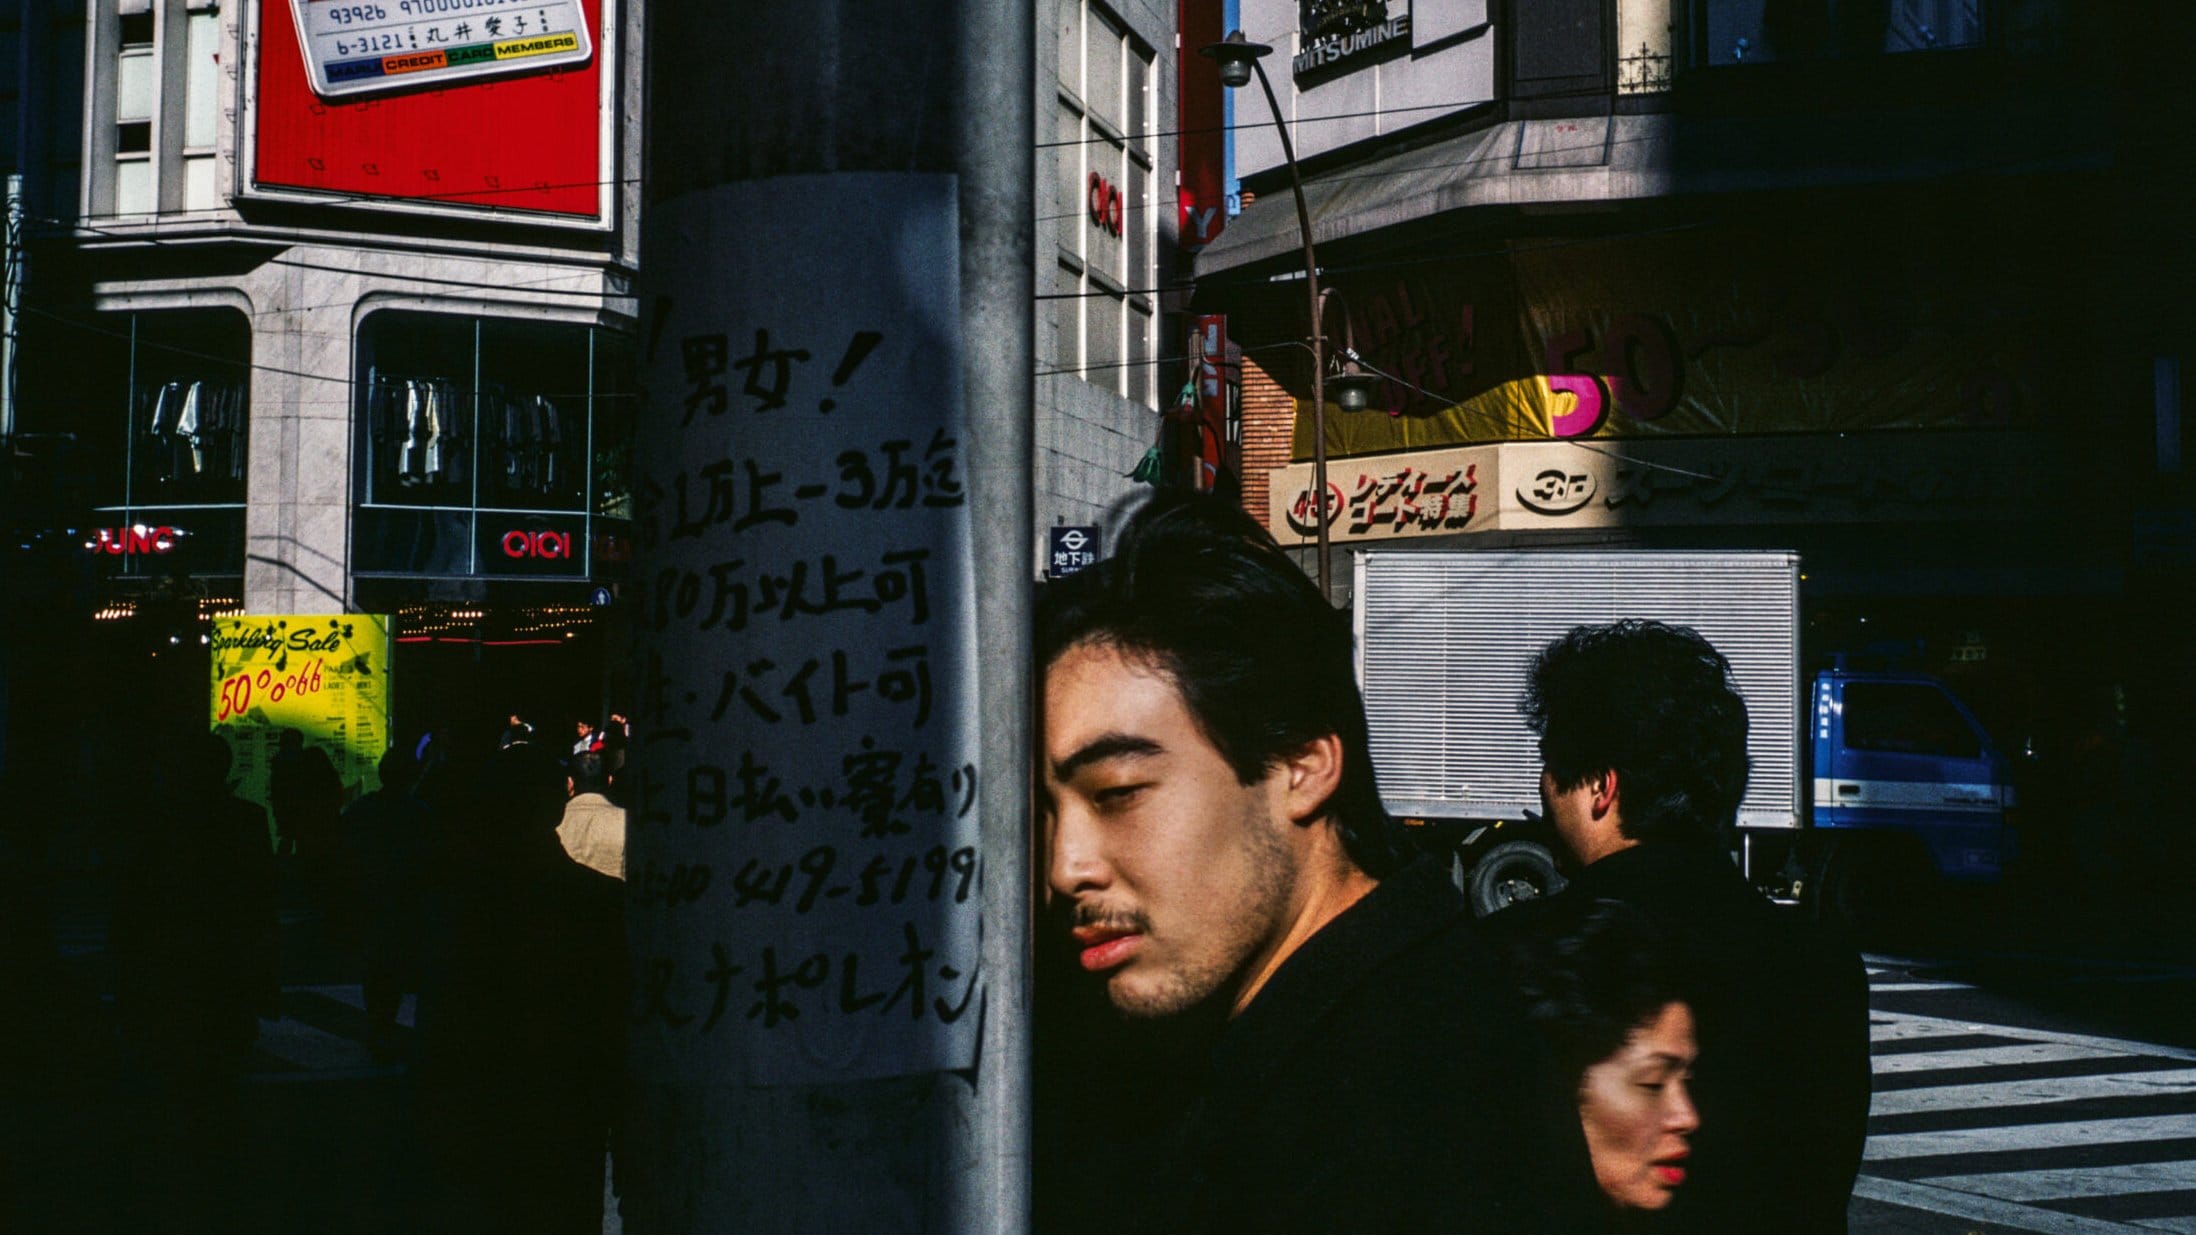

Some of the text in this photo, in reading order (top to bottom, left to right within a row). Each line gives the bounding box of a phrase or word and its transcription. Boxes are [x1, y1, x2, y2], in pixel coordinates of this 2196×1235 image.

[386, 55, 443, 70] CREDIT
[448, 47, 493, 62] CARD
[497, 36, 574, 55] MEMBERS
[1293, 15, 1409, 75] MITSUMINE
[287, 627, 341, 652] Sale
